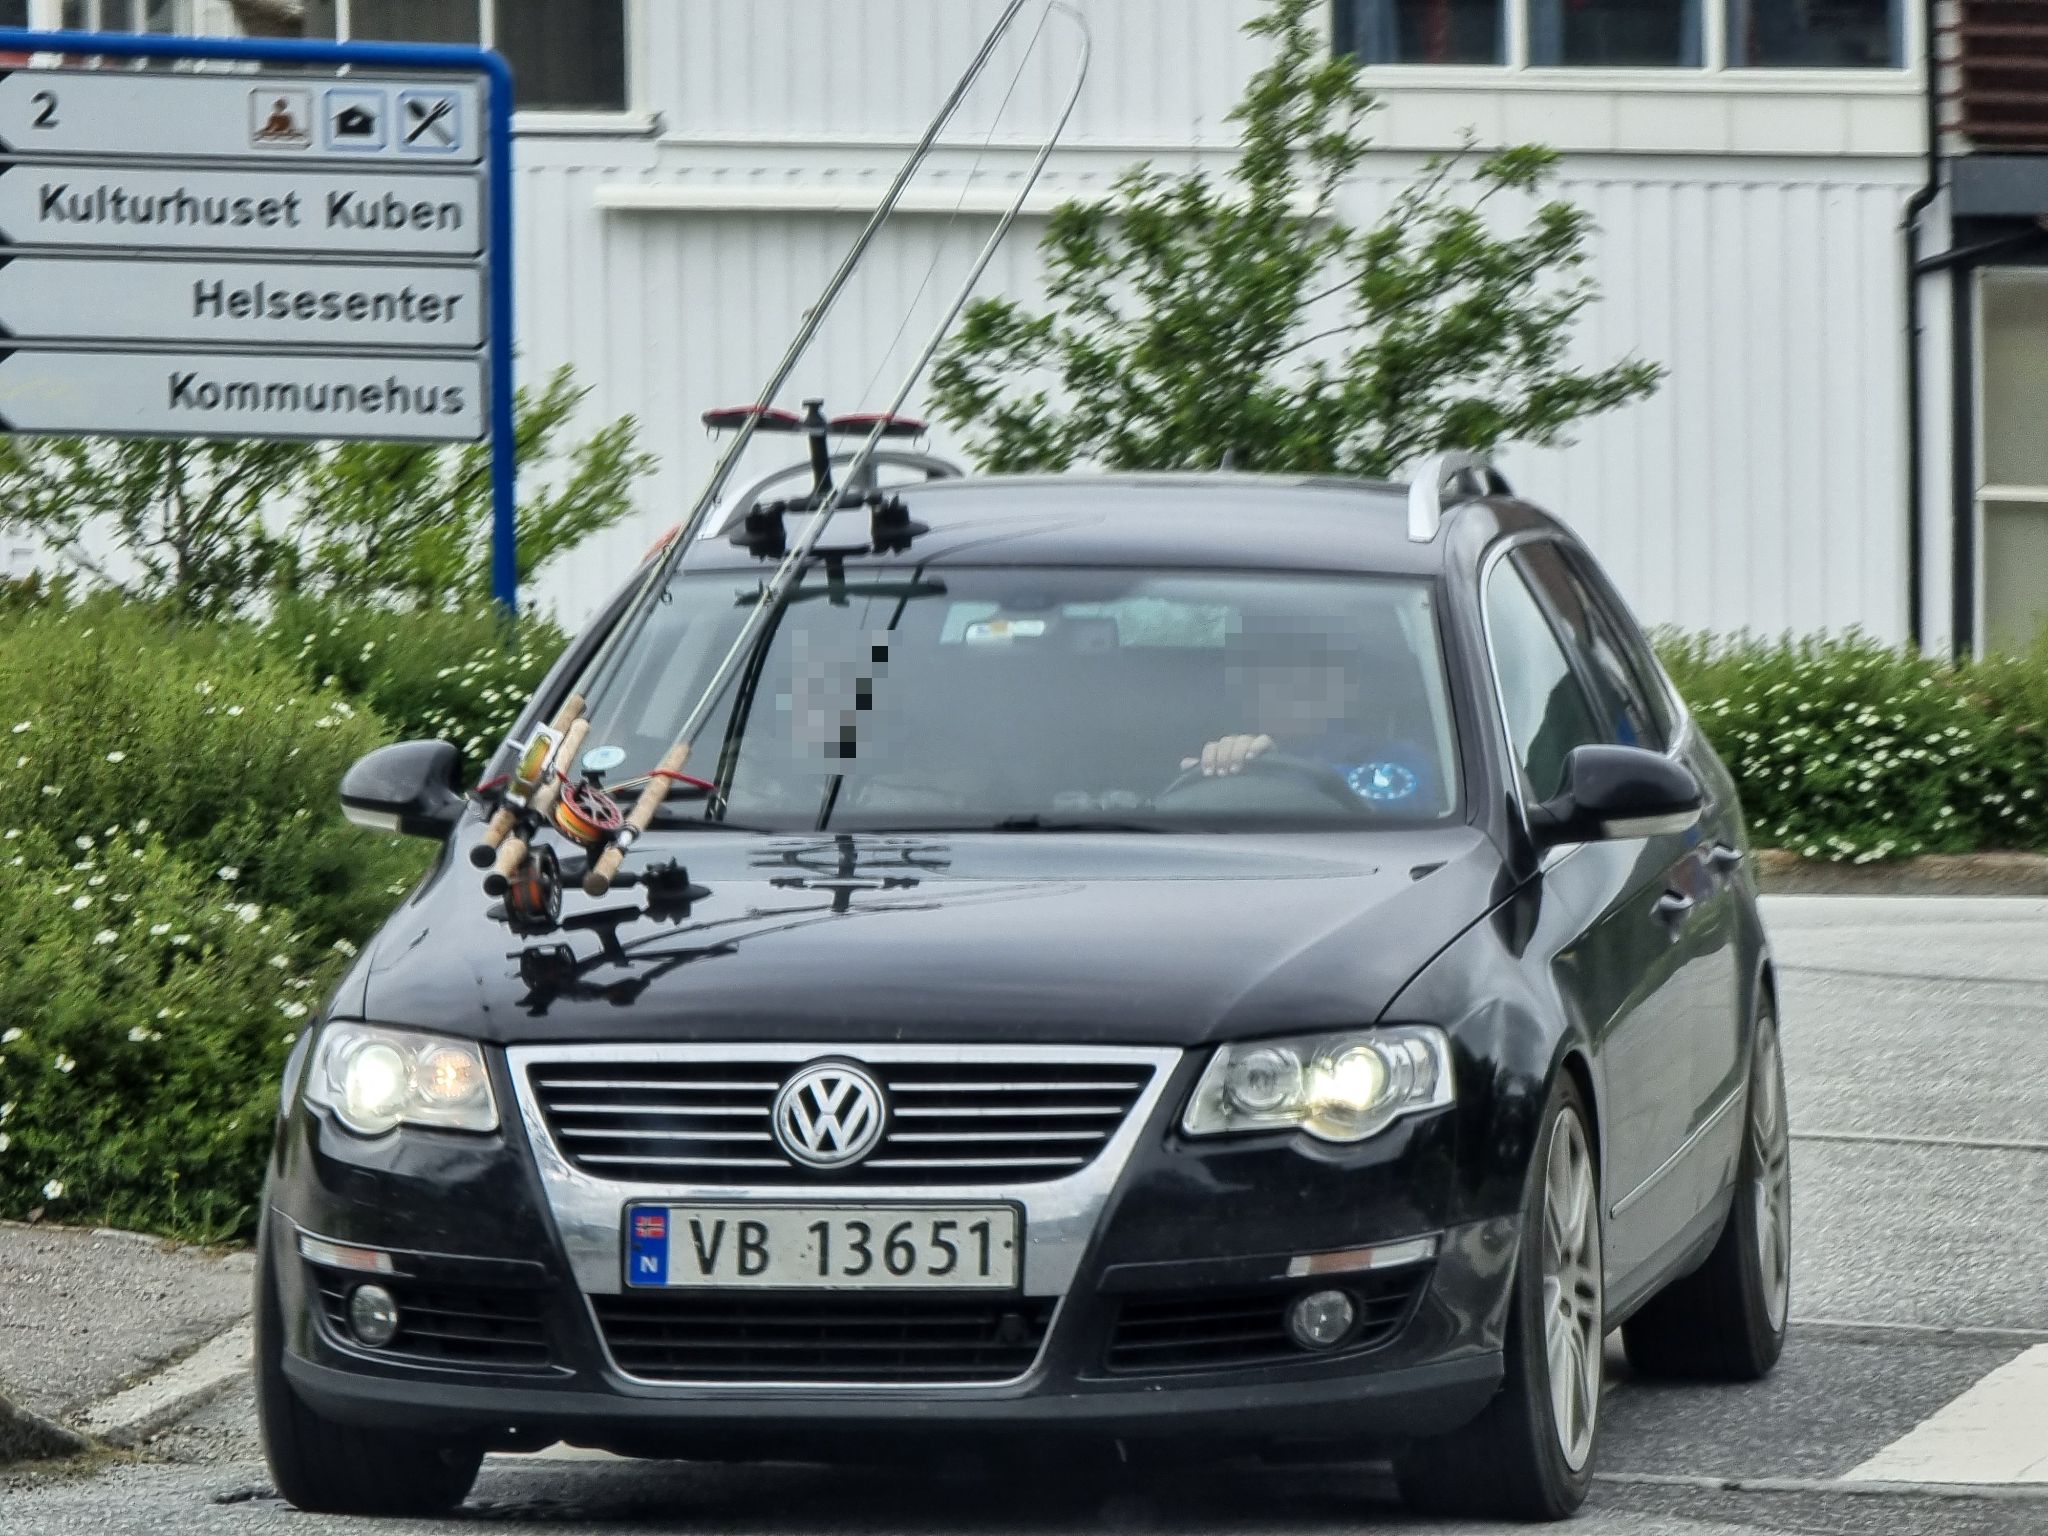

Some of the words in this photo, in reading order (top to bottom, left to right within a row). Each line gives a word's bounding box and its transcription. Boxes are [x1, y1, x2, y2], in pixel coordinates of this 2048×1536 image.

[30, 91, 58, 128] 2
[39, 184, 302, 226] Kulturhuset
[326, 190, 463, 232] Kuben
[193, 278, 464, 322] Helsesenter
[169, 371, 465, 415] Kommunehus
[640, 1256, 658, 1273] N
[689, 1219, 770, 1276] VB
[808, 1220, 991, 1277] 13651
